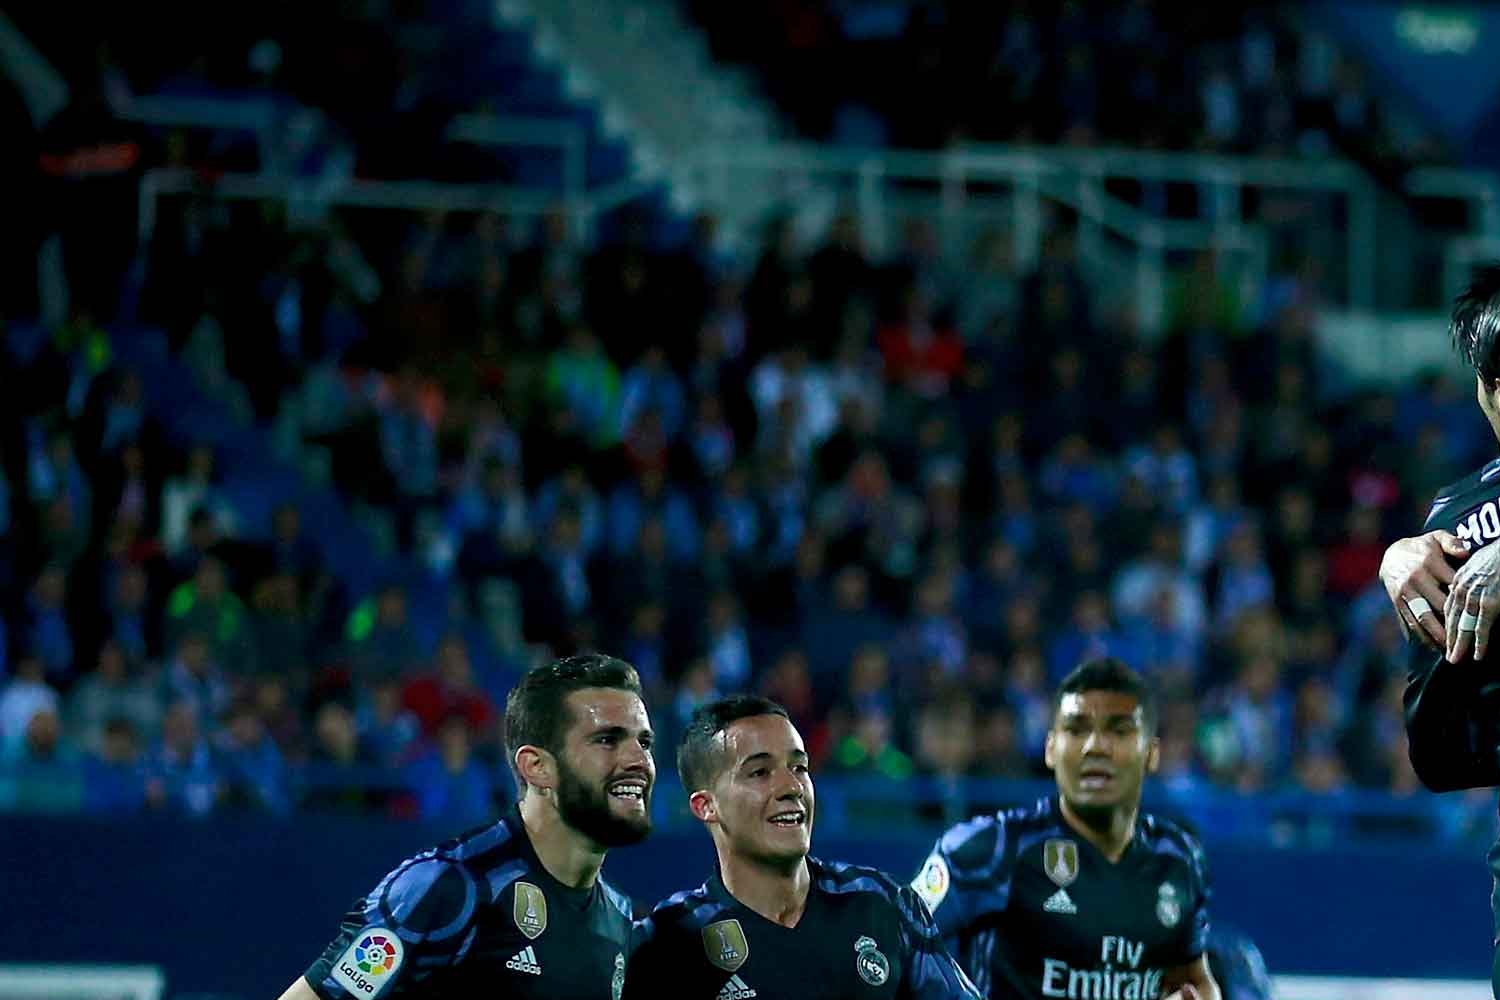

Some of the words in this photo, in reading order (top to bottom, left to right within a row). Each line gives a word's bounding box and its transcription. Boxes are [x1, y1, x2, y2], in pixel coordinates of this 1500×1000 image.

[720, 951, 739, 962] FIFA
[1101, 935, 1144, 970] Fly
[339, 961, 375, 994] LaLiga
[505, 959, 542, 976] adidas
